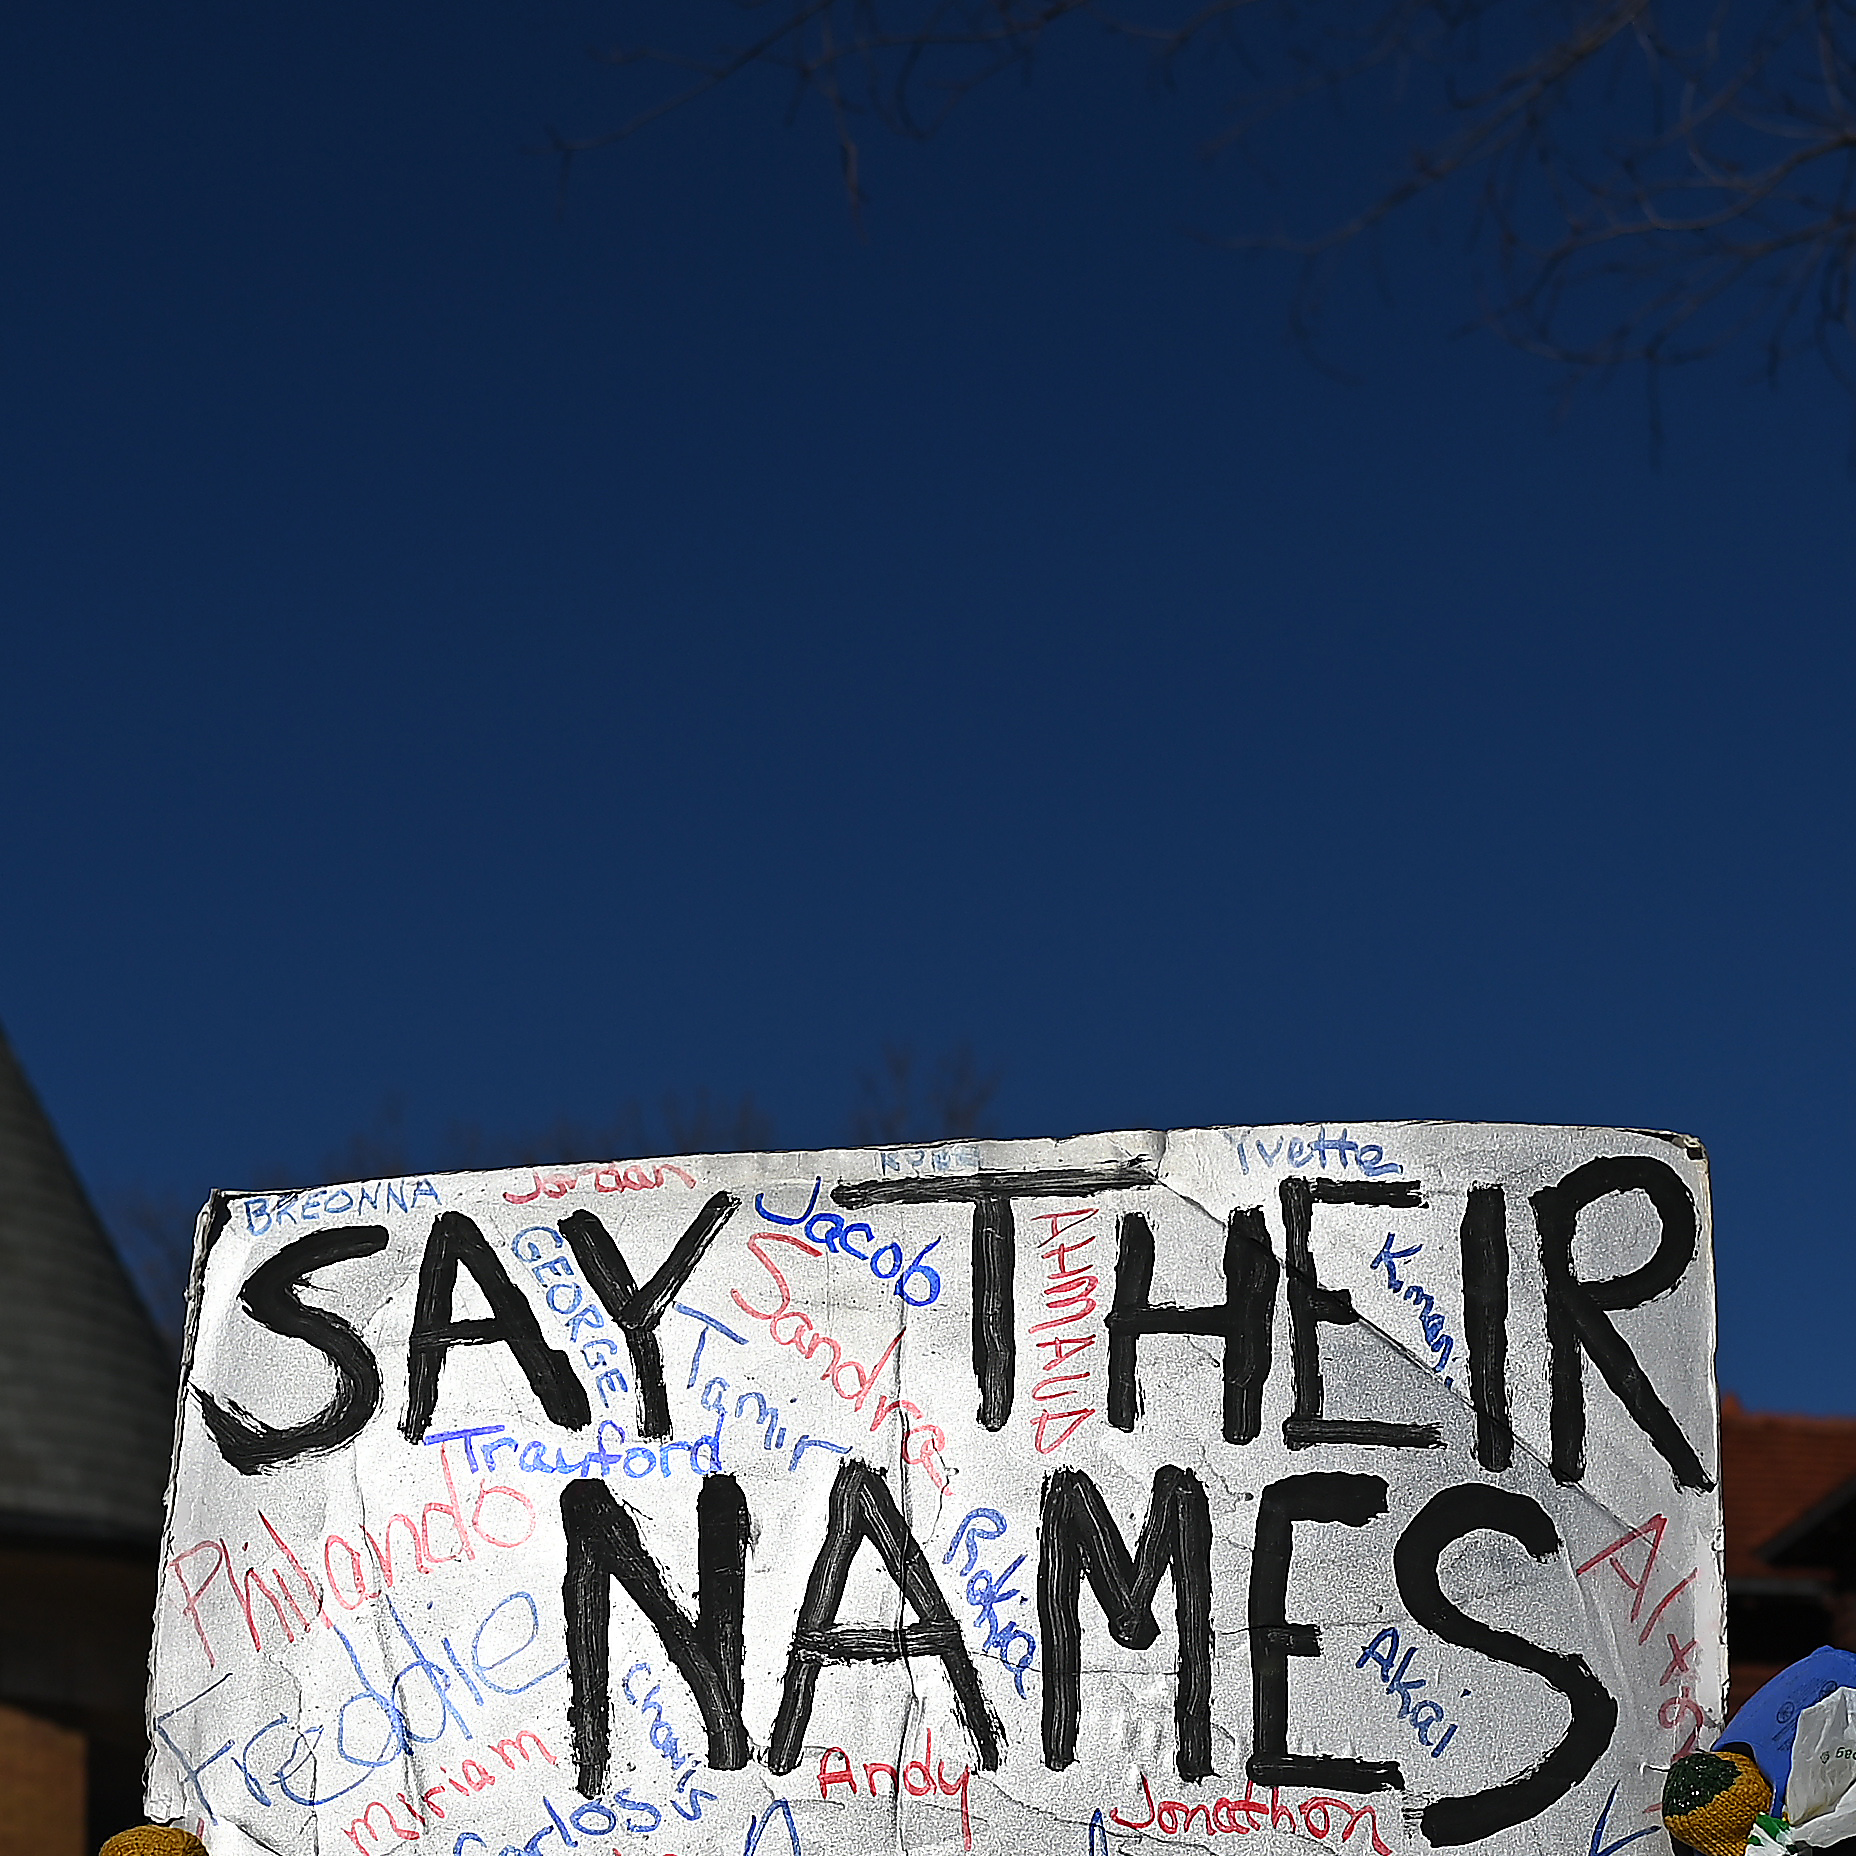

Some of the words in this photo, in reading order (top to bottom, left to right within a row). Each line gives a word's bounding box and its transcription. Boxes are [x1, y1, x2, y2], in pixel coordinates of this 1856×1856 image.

[244, 1178, 443, 1237] BREONNA
[502, 1163, 697, 1204] Jordan
[1219, 1125, 1403, 1176] Yvette
[188, 1191, 741, 1476] SAY
[831, 1153, 1716, 1492] THEIR
[511, 1226, 628, 1408] GEORGE
[755, 1177, 941, 1306] Jacob
[673, 1302, 853, 1471] Tamir
[731, 1232, 953, 1496] Sandra
[1029, 1209, 1099, 1454] AHMAUD
[167, 1442, 536, 1668] Philando
[155, 1591, 569, 1826] Freddie
[560, 1459, 1618, 1848] NAMES
[1355, 1626, 1469, 1758] Akai
[817, 1728, 973, 1850] Andy
